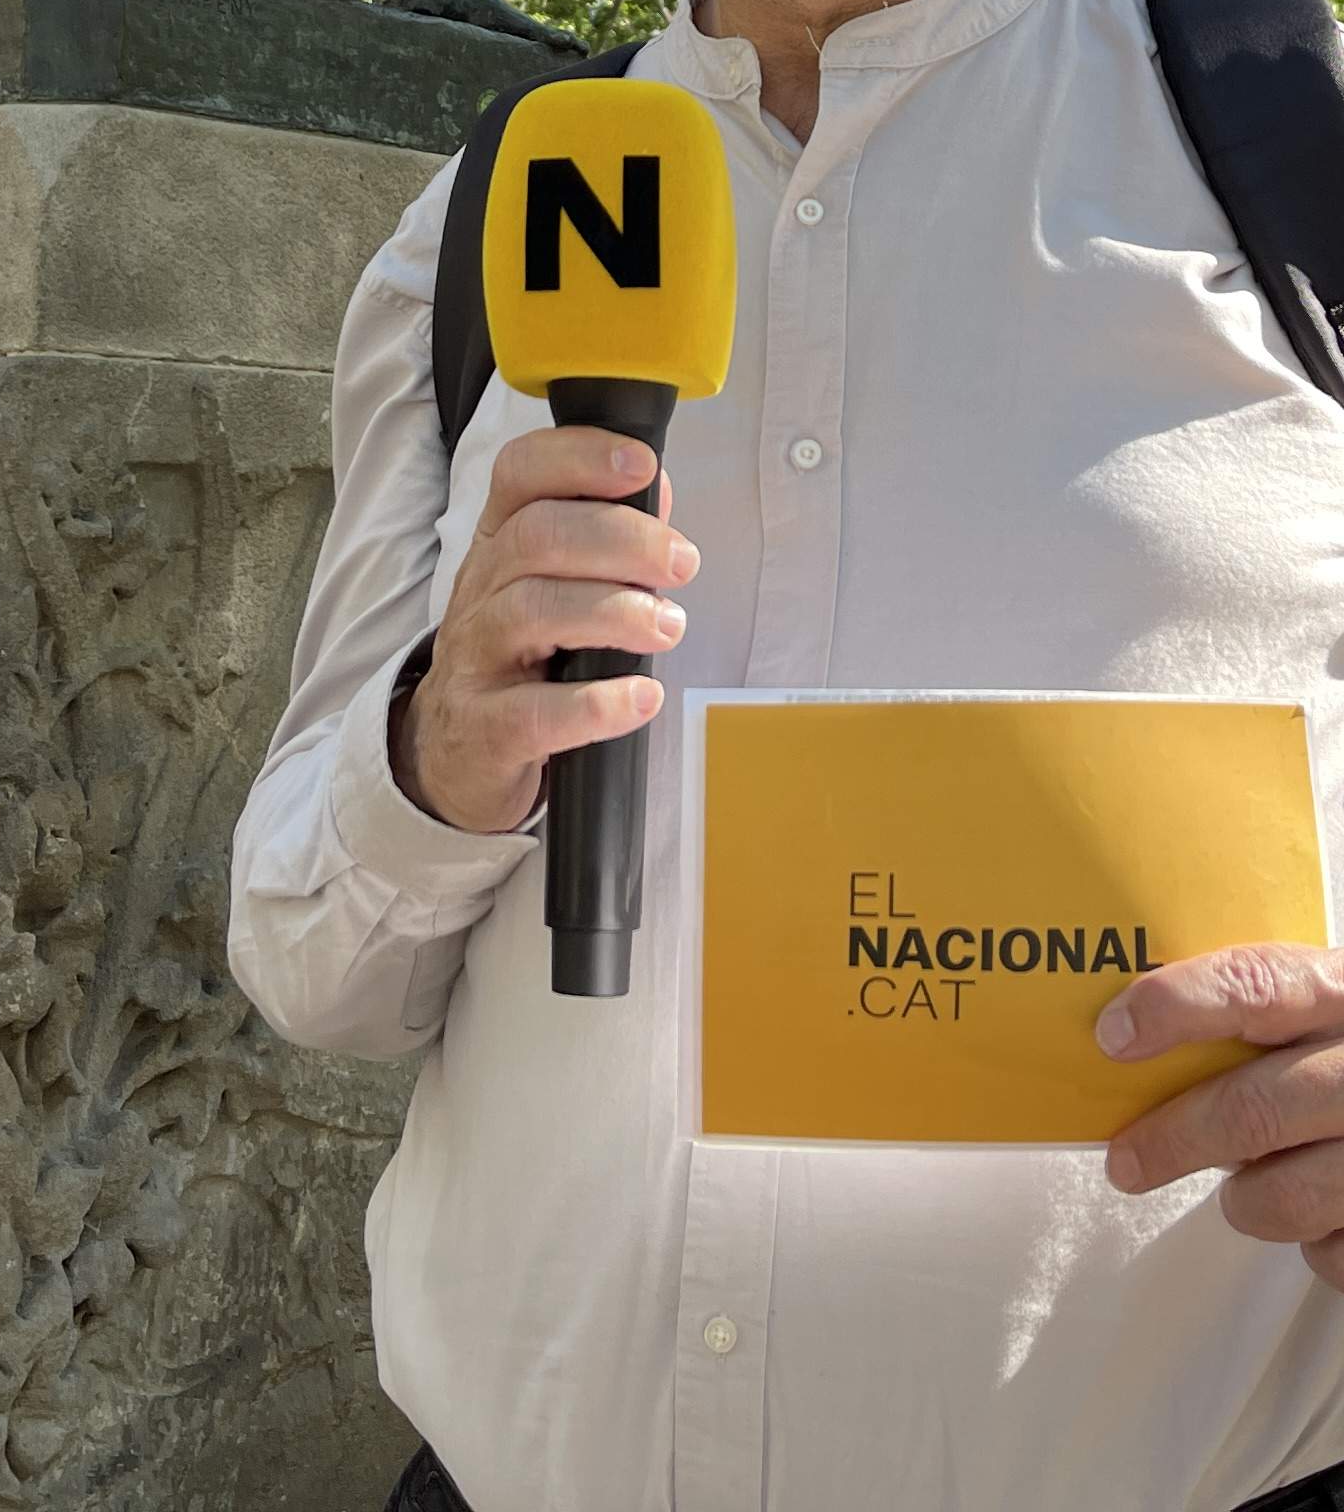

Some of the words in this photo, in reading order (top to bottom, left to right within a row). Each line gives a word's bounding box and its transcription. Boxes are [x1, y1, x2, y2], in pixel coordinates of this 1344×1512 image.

[525, 155, 660, 291] N
[849, 871, 916, 919] EL
[848, 926, 1164, 974] NACIONAL
[847, 976, 976, 1020] .CAT
